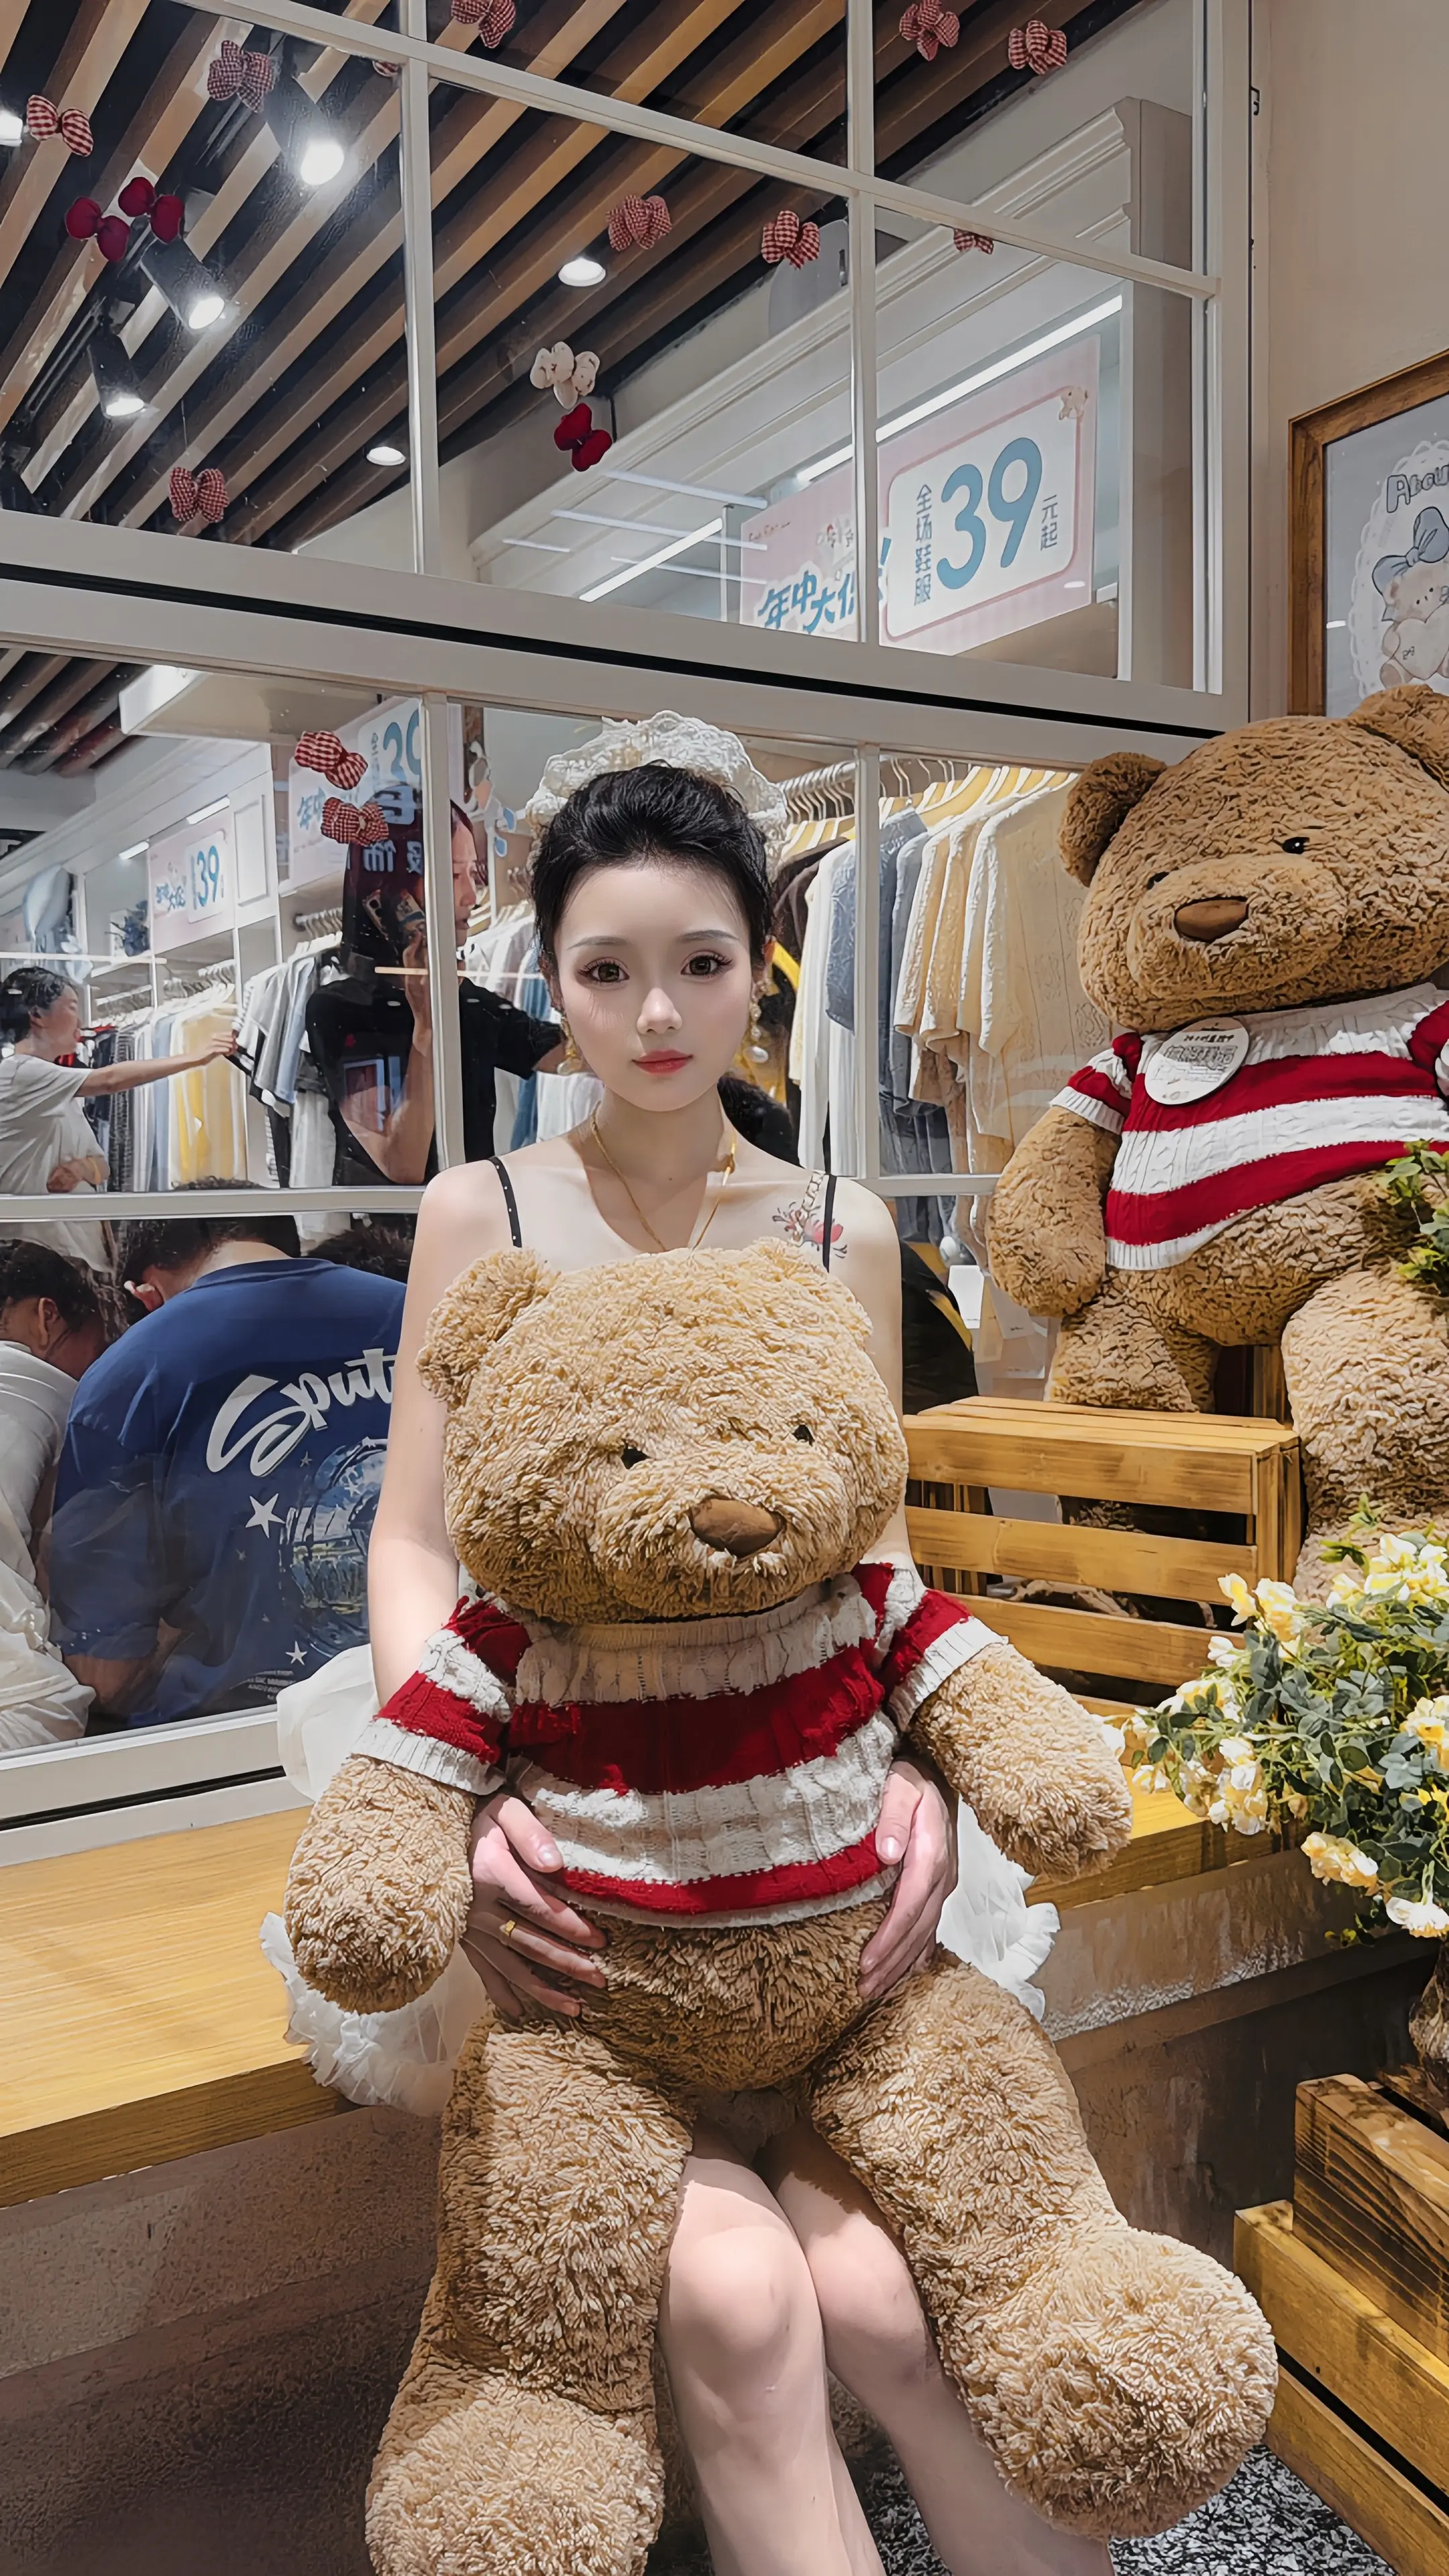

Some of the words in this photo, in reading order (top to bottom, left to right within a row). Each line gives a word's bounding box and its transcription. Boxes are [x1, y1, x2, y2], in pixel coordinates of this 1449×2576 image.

[936, 437, 1042, 590] 39
[1040, 494, 1058, 551] 元起
[196, 845, 219, 908] 39
[206, 1348, 396, 1477] Sput
